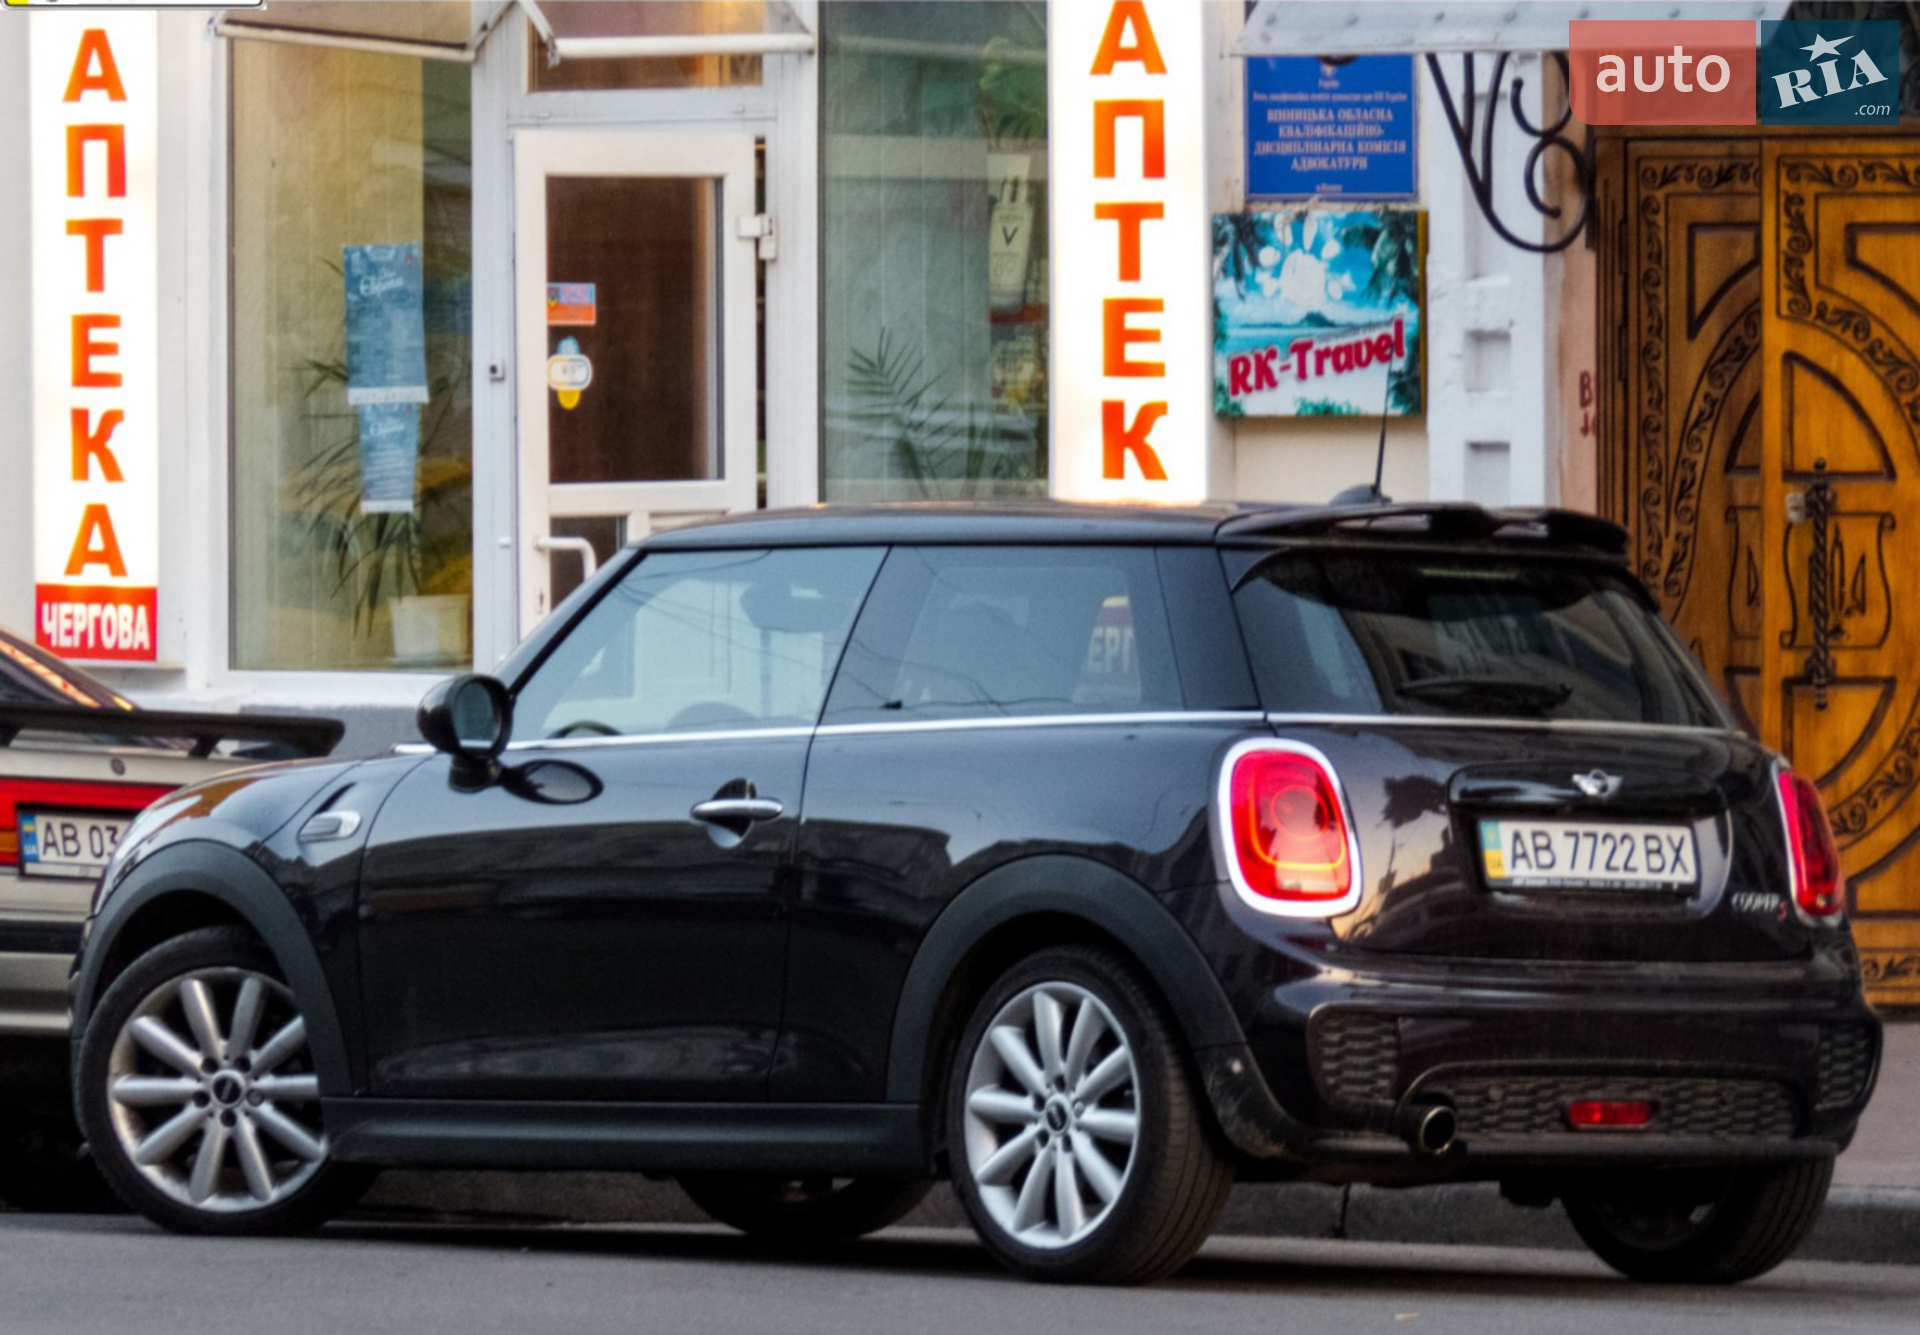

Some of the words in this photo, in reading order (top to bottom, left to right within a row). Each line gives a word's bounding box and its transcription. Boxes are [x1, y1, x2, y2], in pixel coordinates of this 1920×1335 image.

[1337, 108, 1394, 122] ОБЛАСНА
[1291, 156, 1368, 171] АДВОКАТУРИ
[1357, 140, 1407, 154] КОМІСІЯ
[63, 28, 127, 577] АПТЕКА
[1229, 317, 1405, 397] RK-Travel
[41, 602, 151, 651] ЧЕРГОВА
[42, 822, 81, 857] AB
[1511, 830, 1556, 871] AB
[1564, 831, 1639, 873] 7722
[1643, 833, 1690, 876] BX
